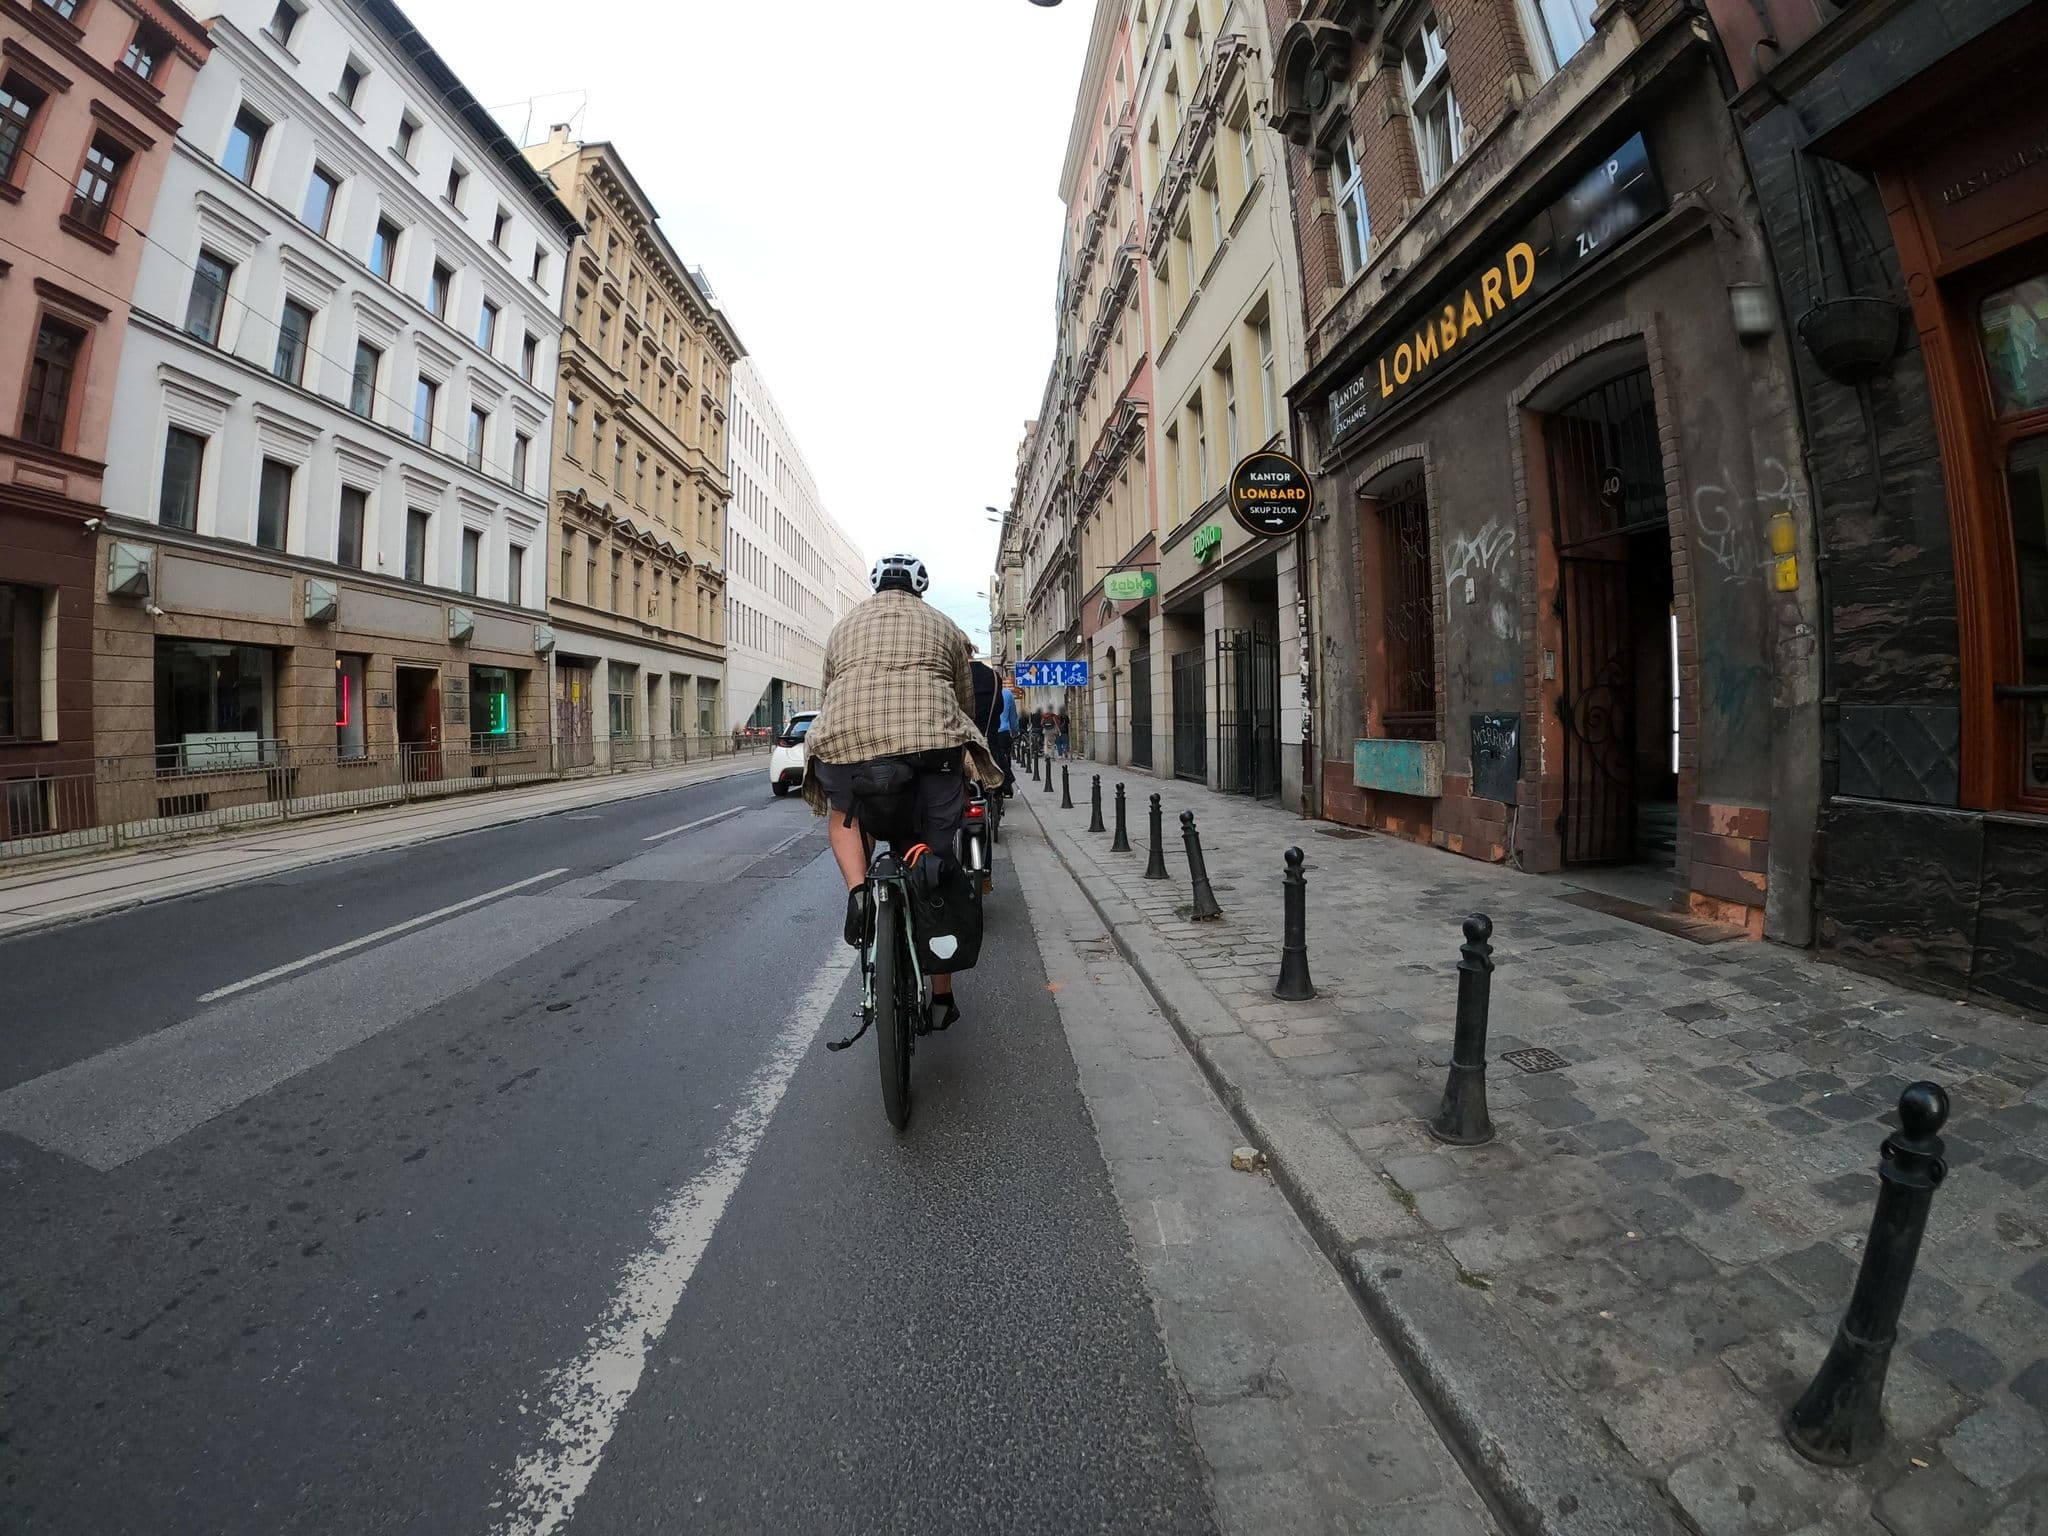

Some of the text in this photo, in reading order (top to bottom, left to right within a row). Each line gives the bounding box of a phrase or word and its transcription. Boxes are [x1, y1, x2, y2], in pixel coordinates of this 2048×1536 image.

[1379, 242, 1535, 399] LOMBARD
[1336, 404, 1367, 434] EXCHANGE
[1250, 472, 1291, 481] KANTOR
[1239, 487, 1306, 500] LOMBARD
[1249, 506, 1271, 514] SKUP
